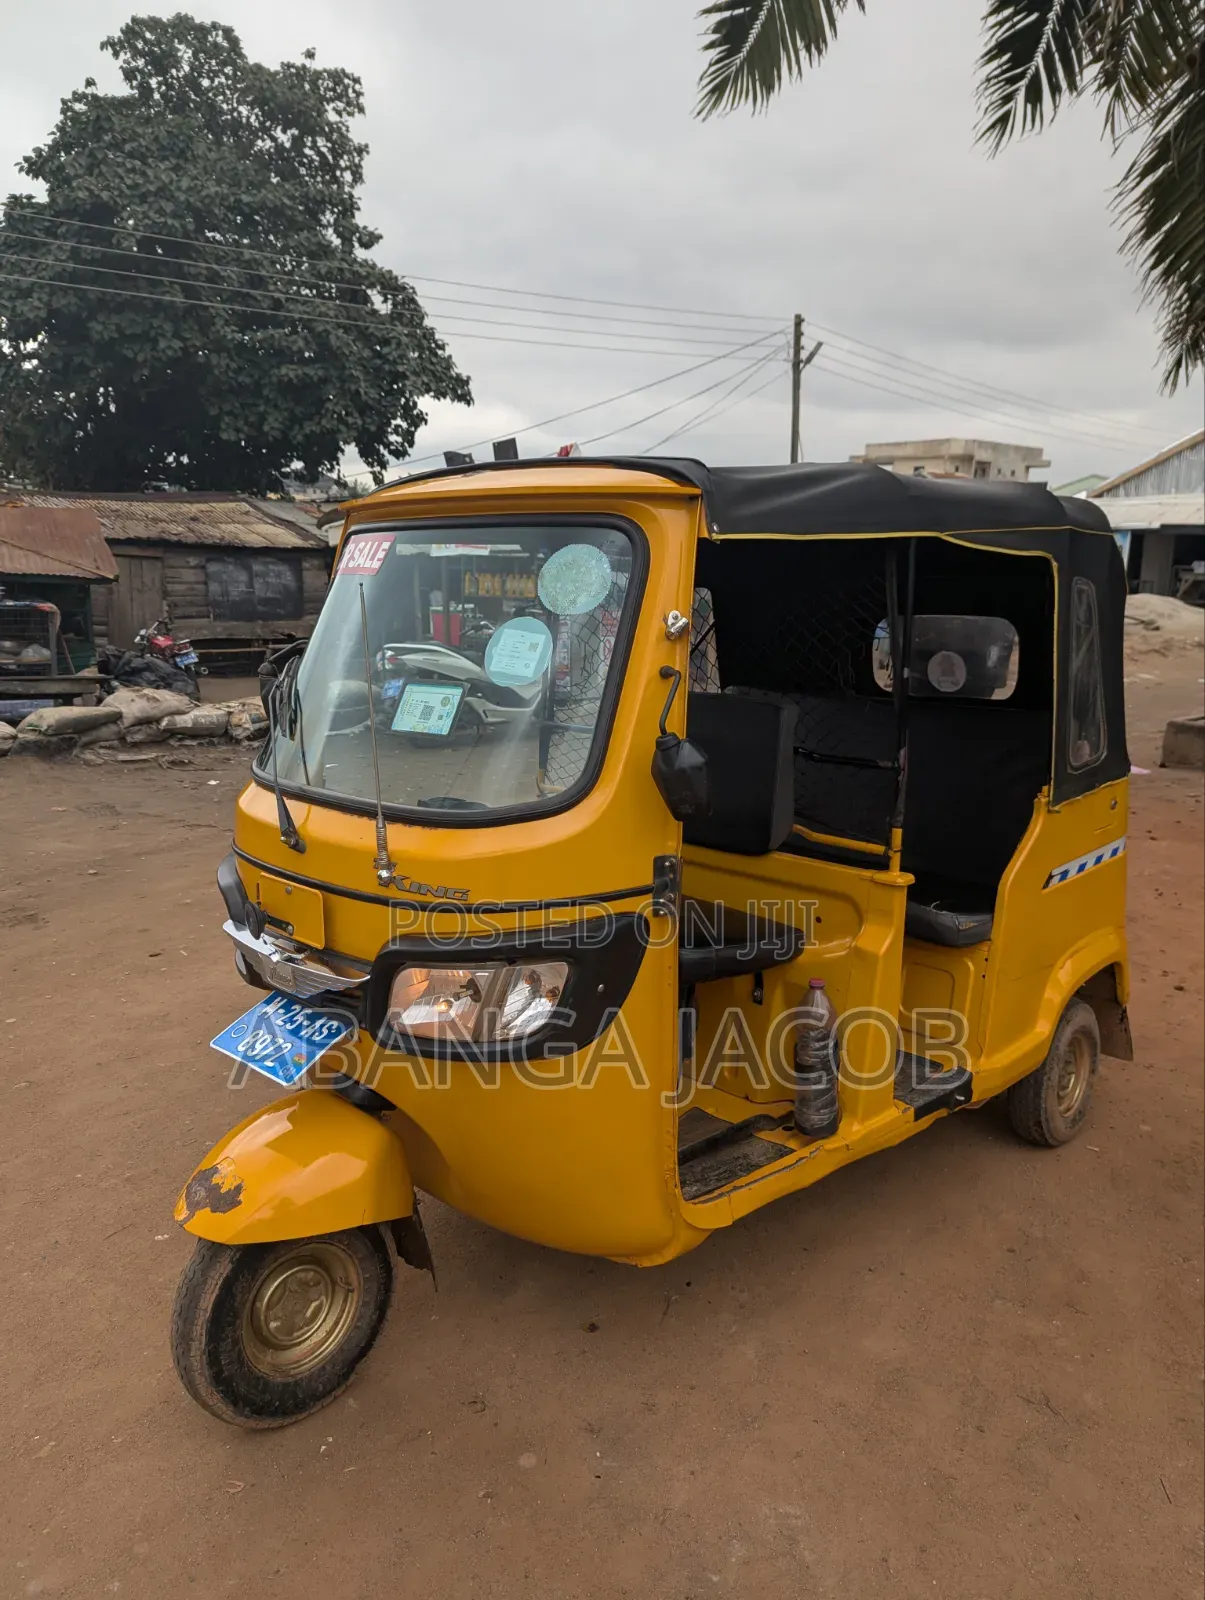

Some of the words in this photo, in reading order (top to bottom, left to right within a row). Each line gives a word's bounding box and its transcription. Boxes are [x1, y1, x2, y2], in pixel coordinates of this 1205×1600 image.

[348, 541, 391, 568] SALE
[379, 874, 470, 901] KING
[258, 997, 339, 1041] M-25-AS
